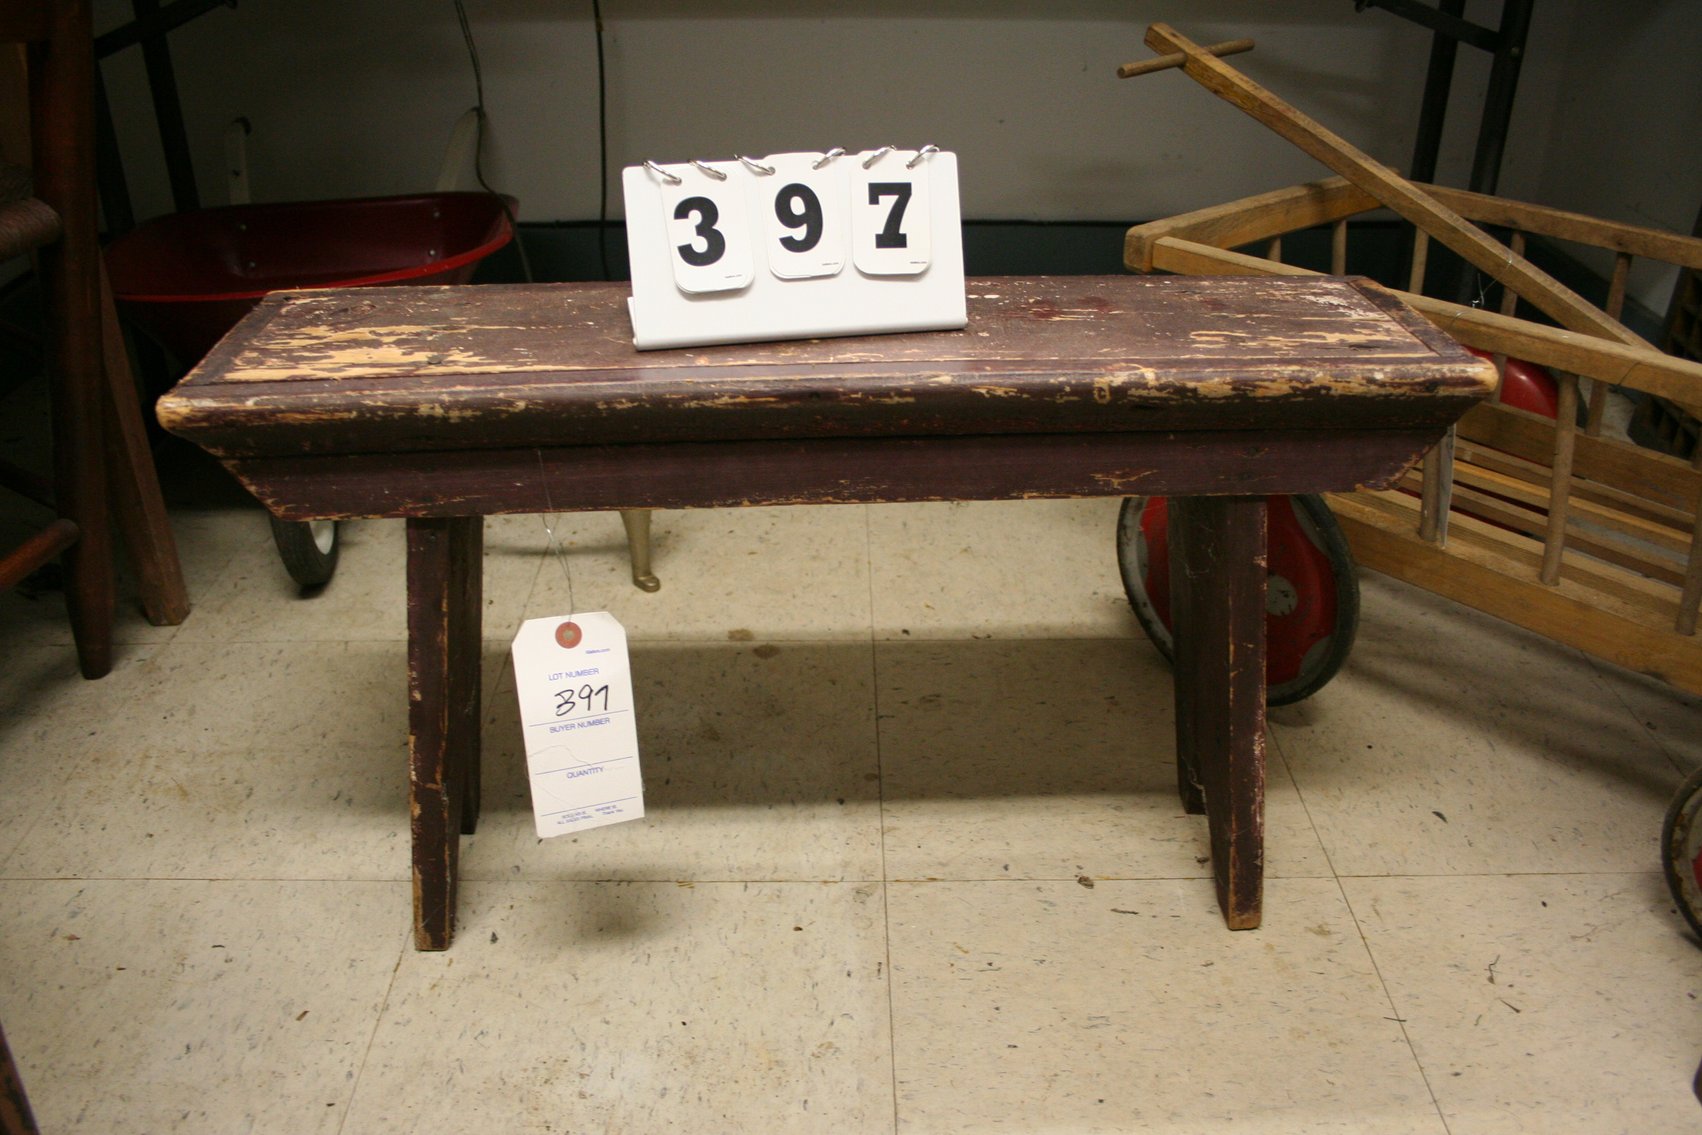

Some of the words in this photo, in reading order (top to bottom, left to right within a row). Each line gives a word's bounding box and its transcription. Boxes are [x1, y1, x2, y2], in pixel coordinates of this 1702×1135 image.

[673, 195, 726, 268] 3
[774, 182, 824, 254] 9
[867, 181, 913, 249] 7
[548, 672, 563, 681] LOT
[565, 667, 600, 678] NUMBER
[554, 683, 609, 717] 397
[549, 723, 577, 734] BUYER
[577, 716, 611, 729] NUMBER
[566, 766, 604, 779] QUANTITY
